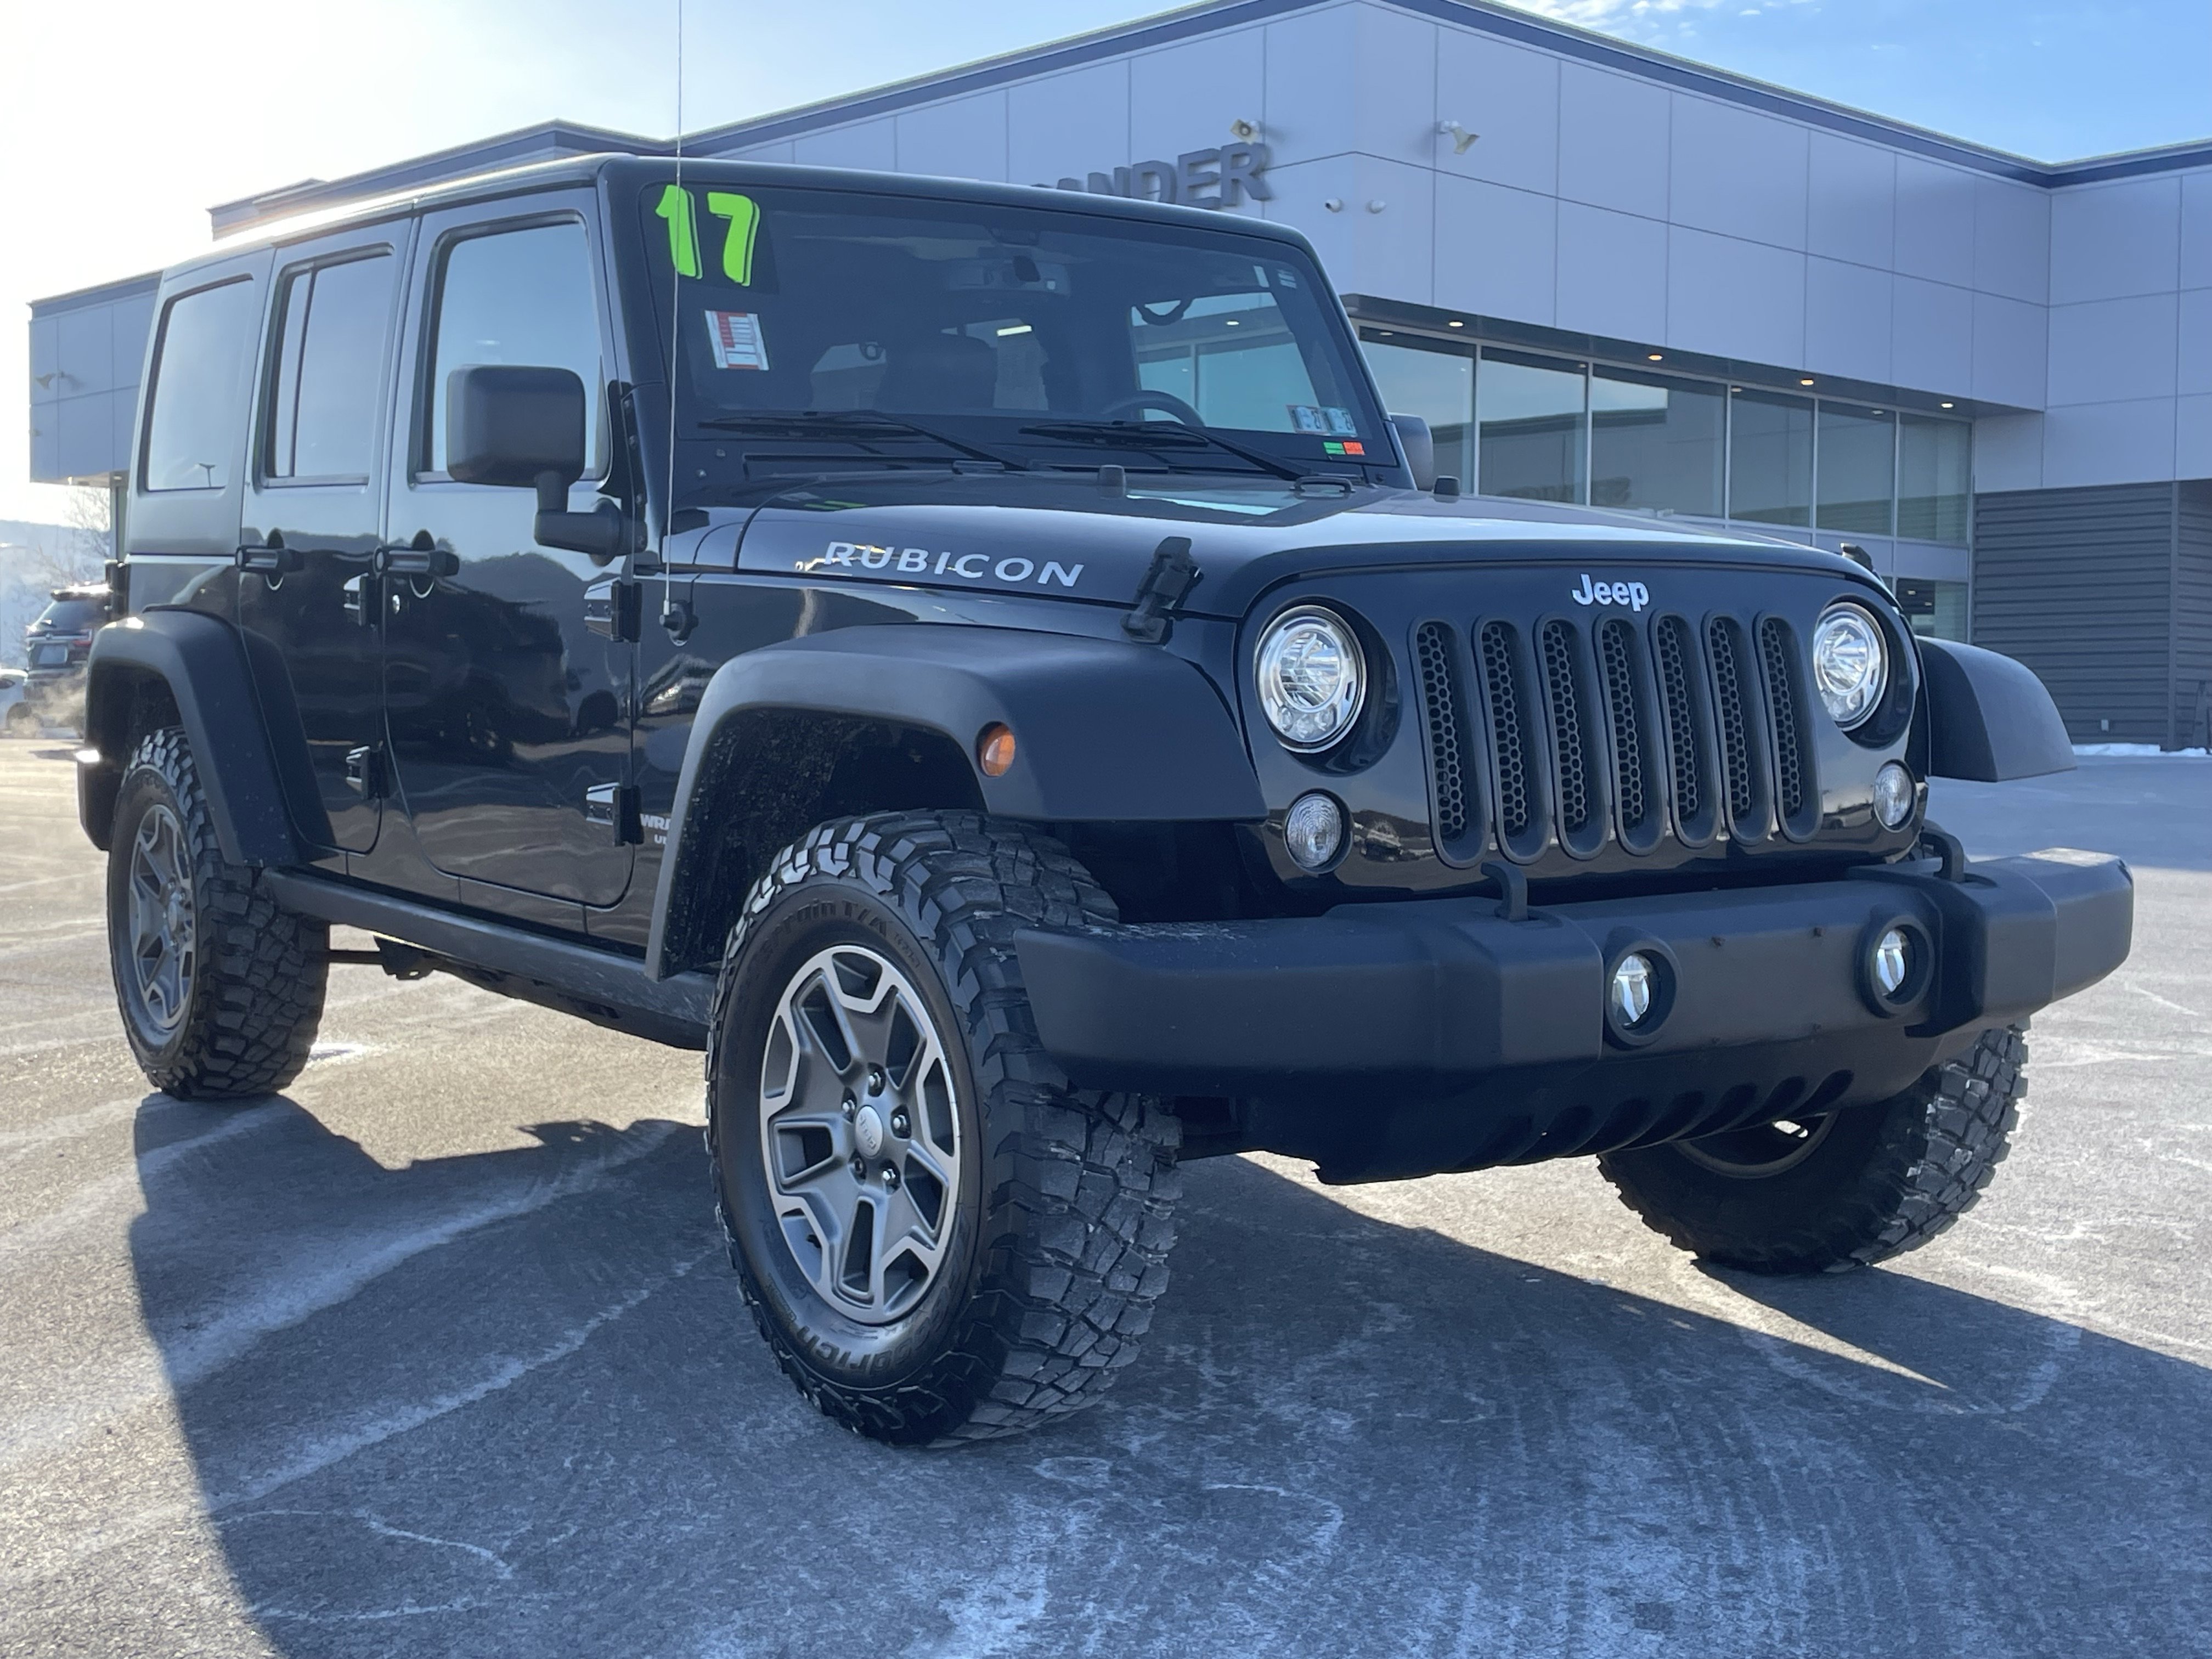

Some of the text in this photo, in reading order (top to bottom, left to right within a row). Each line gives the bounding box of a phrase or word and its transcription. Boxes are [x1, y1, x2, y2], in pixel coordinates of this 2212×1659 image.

[655, 184, 760, 287] 17
[824, 540, 1084, 587] RUBICON
[1571, 573, 1650, 612] Jeep
